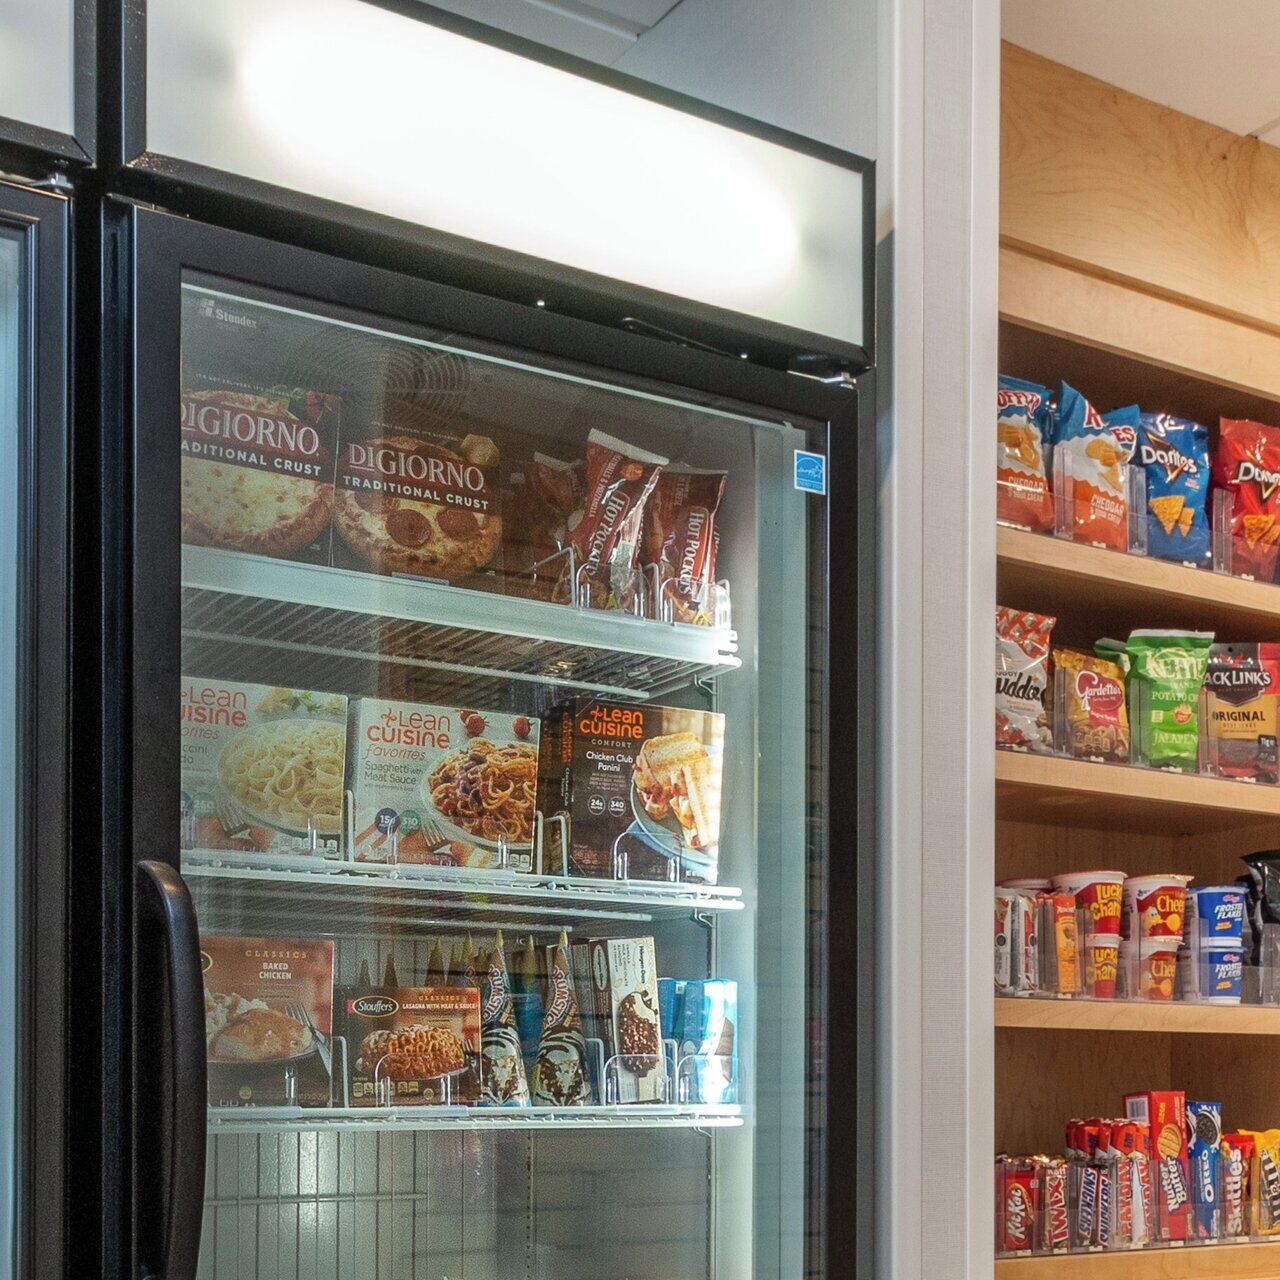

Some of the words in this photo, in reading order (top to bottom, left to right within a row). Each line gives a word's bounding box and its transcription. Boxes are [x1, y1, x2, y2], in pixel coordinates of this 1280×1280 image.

[181, 440, 267, 466] ADITIONAL
[274, 457, 322, 477] CRUST
[348, 441, 485, 492] DIGIORNO
[1141, 445, 1199, 474] Doritos
[342, 475, 441, 501] TRADITIONAL
[446, 493, 490, 510] CRUST
[605, 494, 626, 522] HOT
[687, 511, 706, 537] HOT
[586, 520, 613, 577] POCKETS
[679, 538, 701, 595] POCKETS
[1204, 670, 1231, 687] ACK
[1232, 670, 1272, 687] LINK'S
[188, 685, 248, 710] Lean
[1152, 690, 1186, 702] POTATO
[397, 709, 452, 732] Lean
[602, 707, 644, 726] Lean
[1211, 710, 1266, 722] ORIGINAL
[362, 743, 427, 761] favorites
[590, 738, 633, 749] COMFORT
[585, 750, 616, 763] Chicken
[615, 753, 634, 764] Club
[364, 760, 410, 778] Spaghetti
[597, 762, 622, 772] Panini
[364, 771, 389, 783] Meat
[388, 773, 418, 786] Sauce
[610, 800, 625, 809] 340
[1156, 895, 1186, 913] Chee
[244, 949, 308, 961] CLASSICS
[262, 961, 290, 971] BAKED
[258, 970, 293, 981] CHICKEN
[356, 998, 395, 1014] Stouffer's
[402, 1002, 426, 1010] LASAGNA
[426, 1002, 440, 1010] WITH
[440, 1002, 453, 1010] MEAT
[458, 1002, 477, 1010] SAUCE
[1167, 1154, 1187, 1203] Butter
[1201, 1149, 1214, 1203] OREO
[1226, 1147, 1243, 1235] Skittles
[1079, 1167, 1098, 1237] SNICKERS
[1048, 1177, 1070, 1246] TWIX
